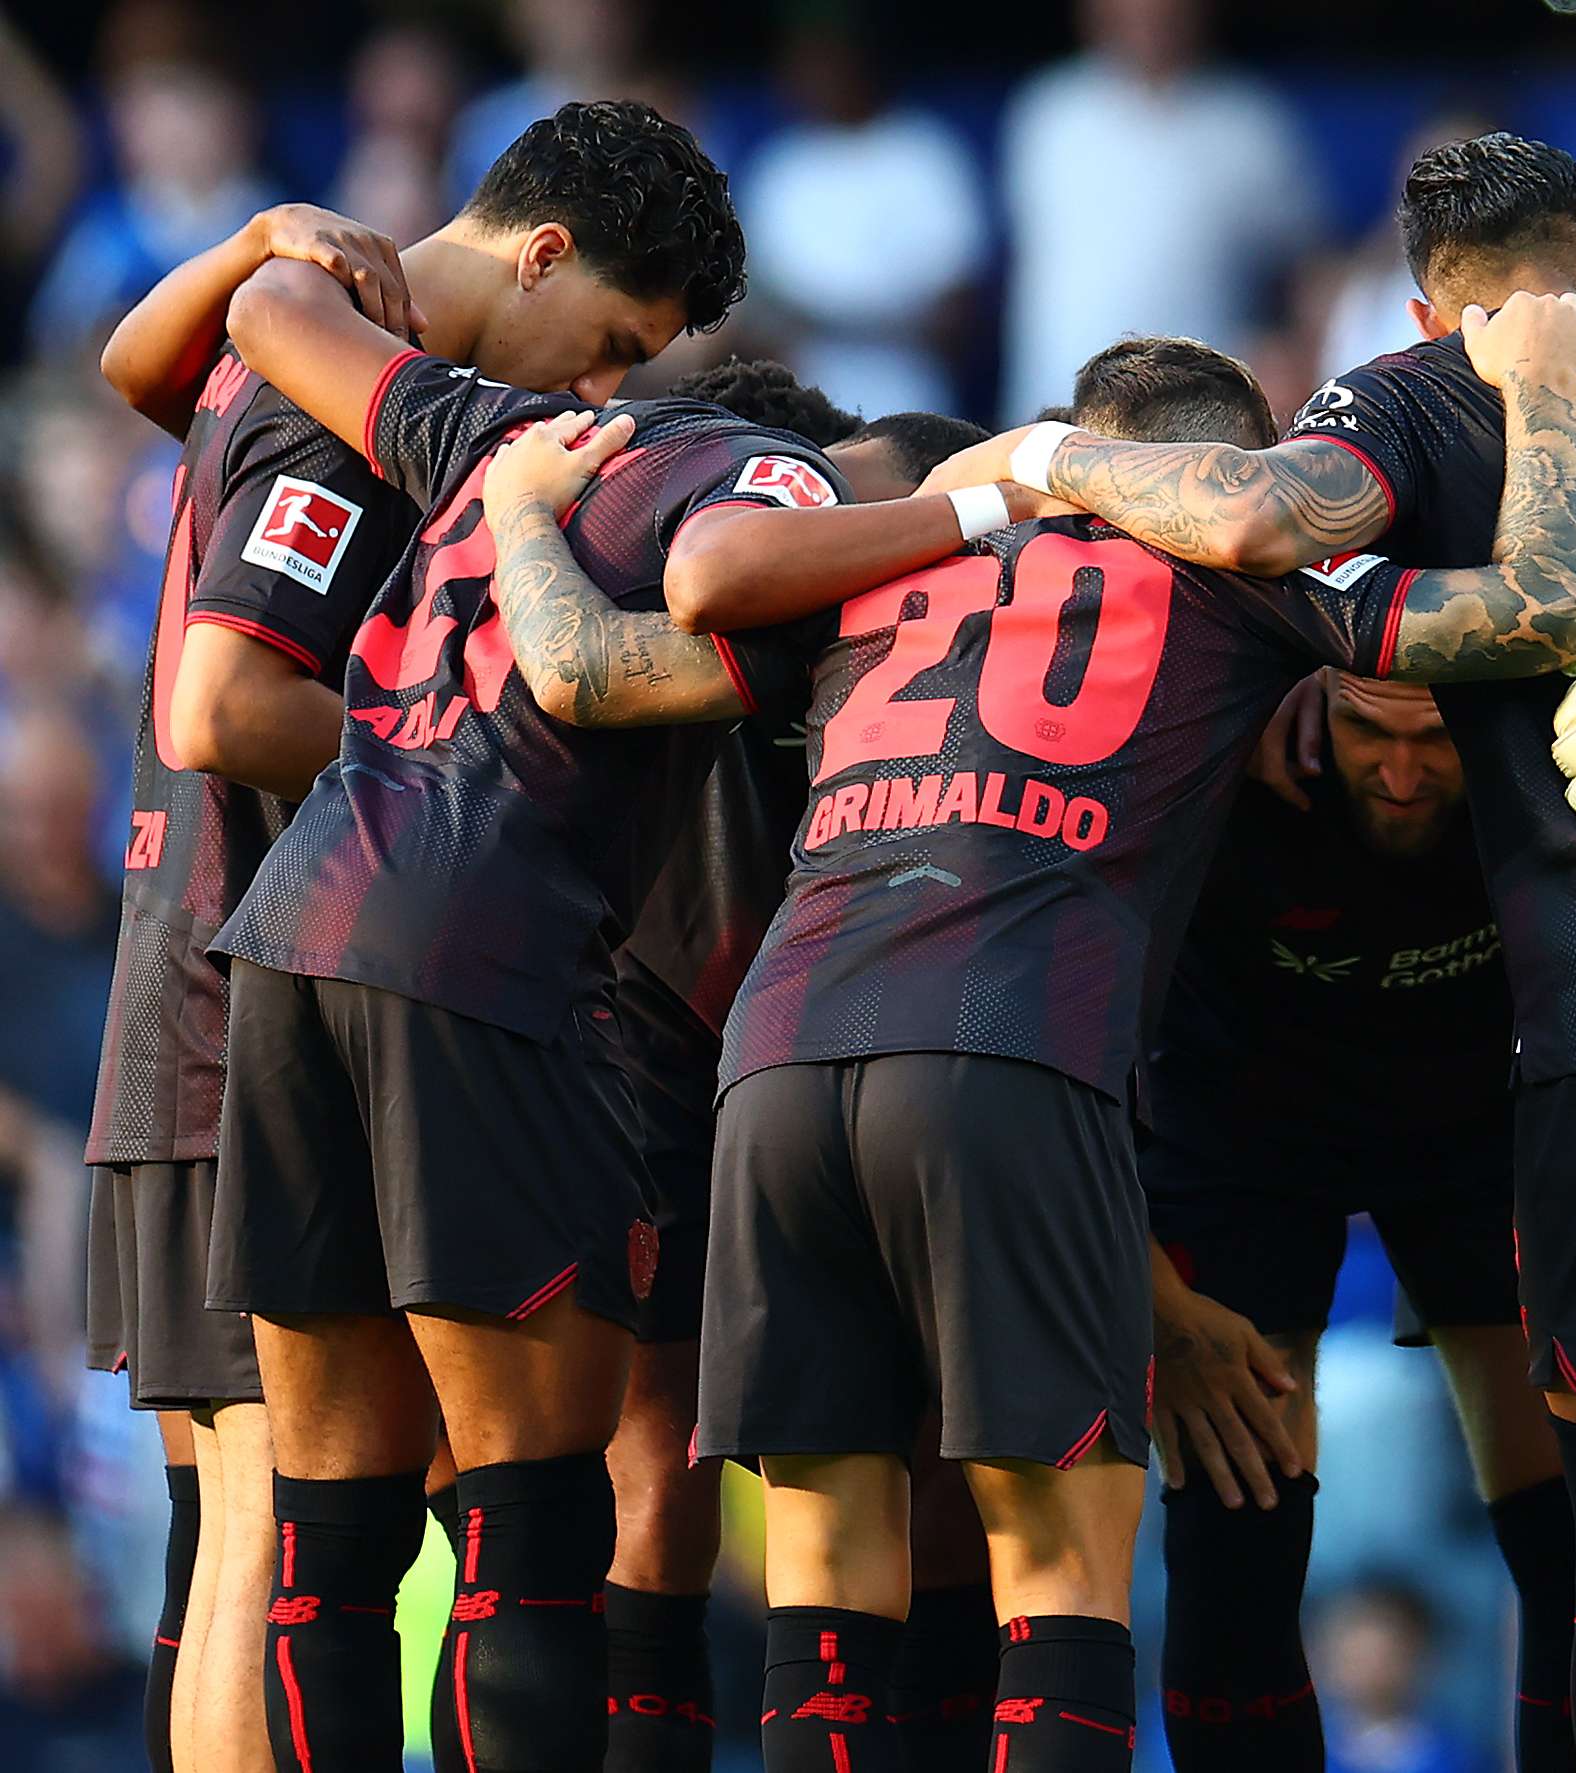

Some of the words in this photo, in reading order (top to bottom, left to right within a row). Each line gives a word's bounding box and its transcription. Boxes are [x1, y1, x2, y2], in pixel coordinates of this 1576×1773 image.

[252, 546, 323, 582] BUNDESLIGA
[818, 532, 1173, 787] 20
[124, 811, 167, 869] ZA
[805, 772, 1110, 852] GRIMALDO
[1389, 923, 1499, 970] Barm
